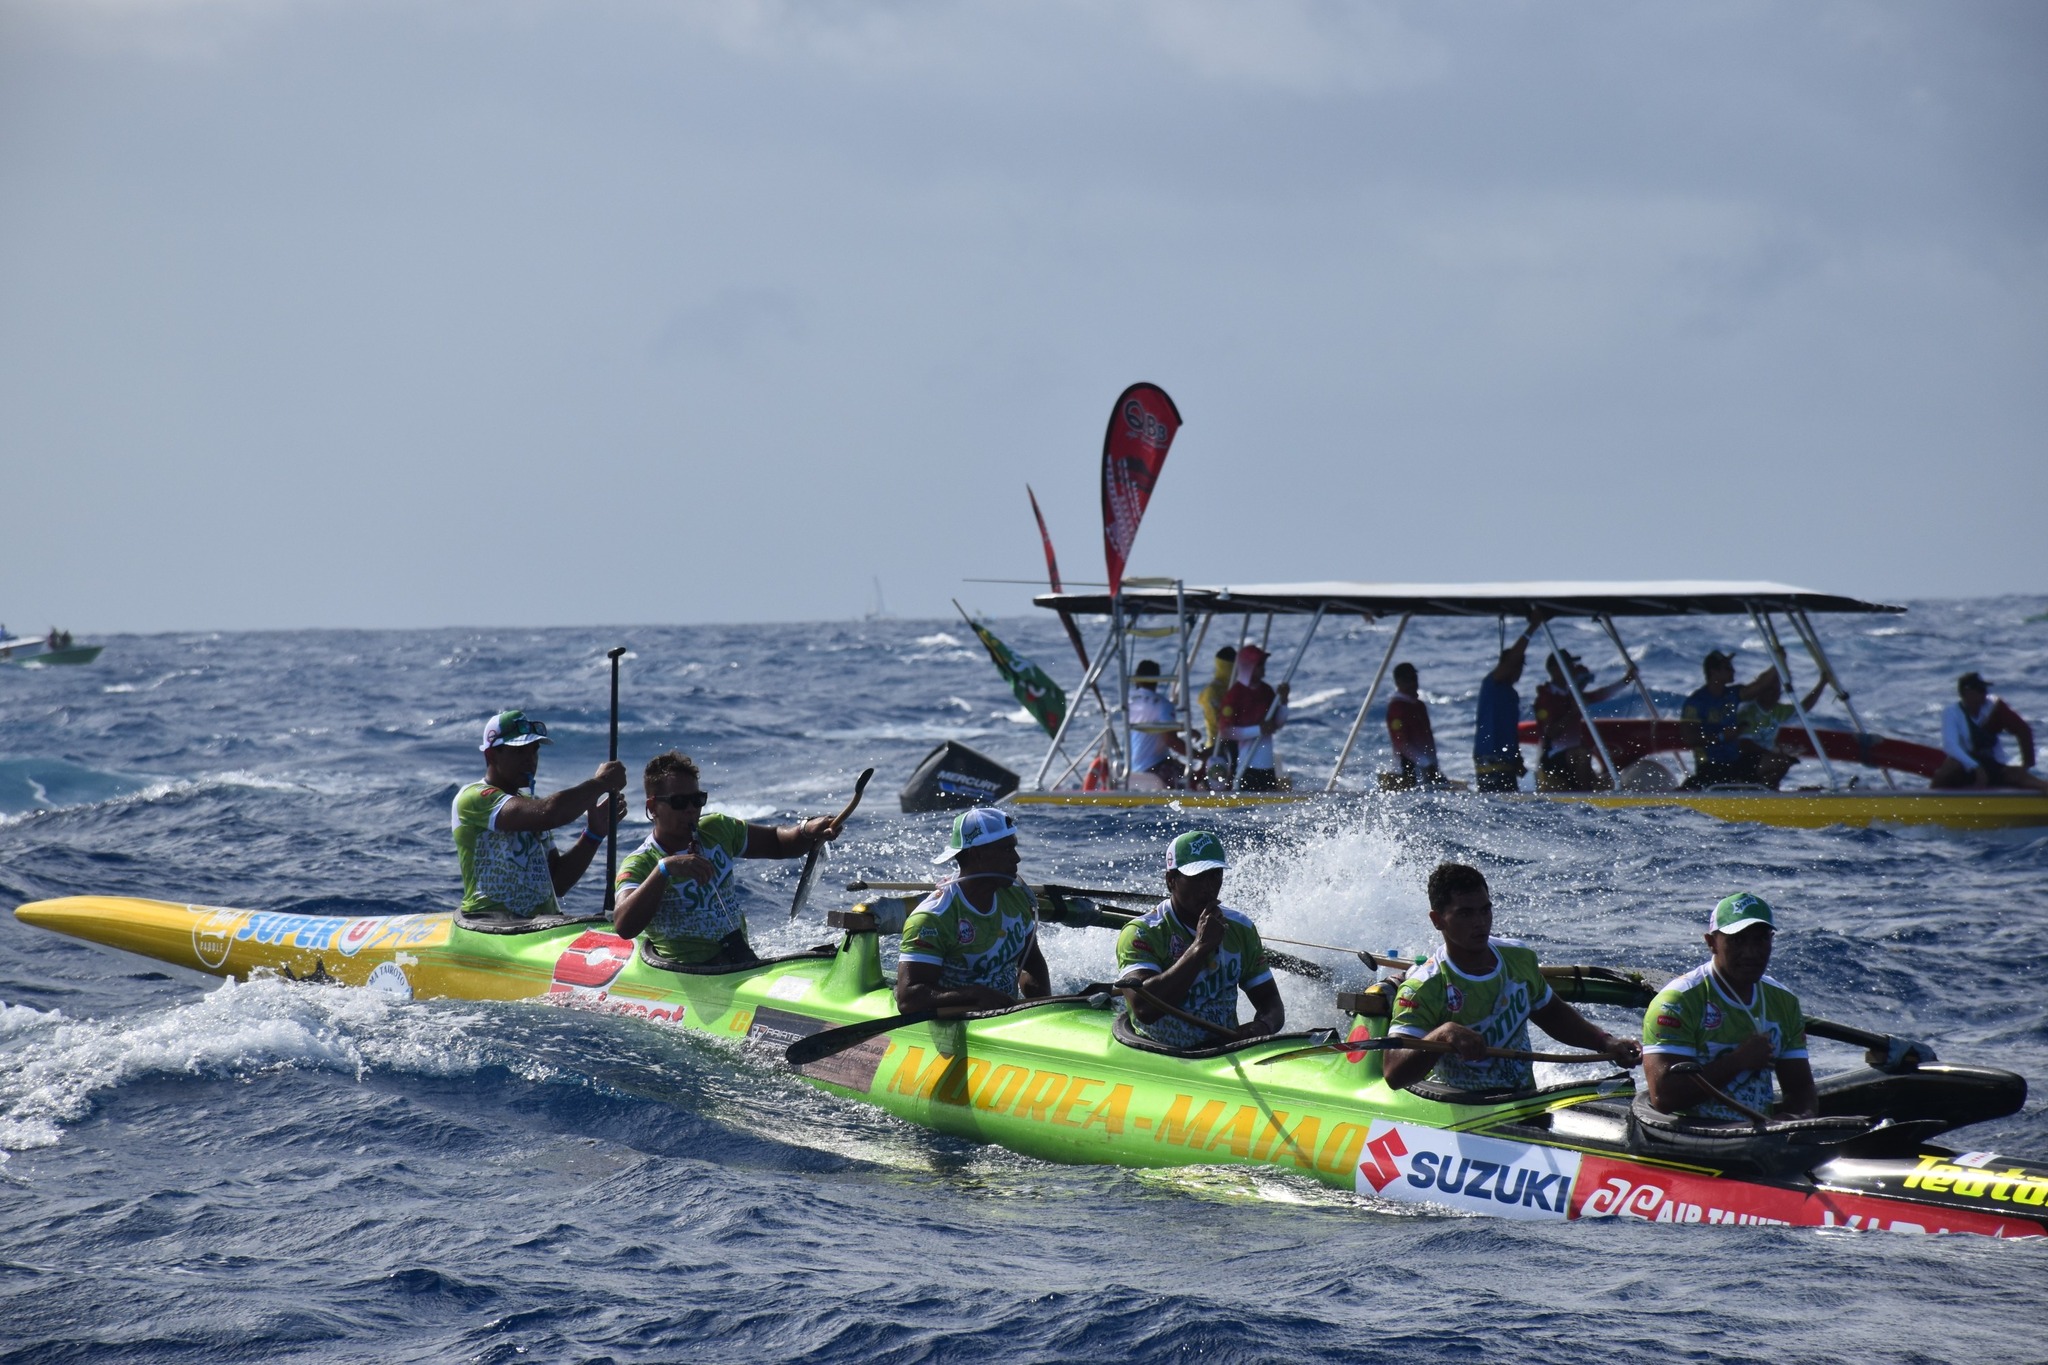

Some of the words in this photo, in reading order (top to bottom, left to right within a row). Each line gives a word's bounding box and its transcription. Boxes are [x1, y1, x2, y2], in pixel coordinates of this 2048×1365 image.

[938, 770, 1001, 791] MERCURY
[1191, 835, 1212, 854] Sprite
[200, 941, 224, 953] PADDLE
[236, 911, 349, 951] SUPER
[973, 921, 1026, 976] Sprite
[1187, 958, 1238, 1008] prite
[1471, 988, 1527, 1046] prite
[1407, 1151, 1572, 1213] SUZUKI
[1903, 1154, 2048, 1207] Teata
